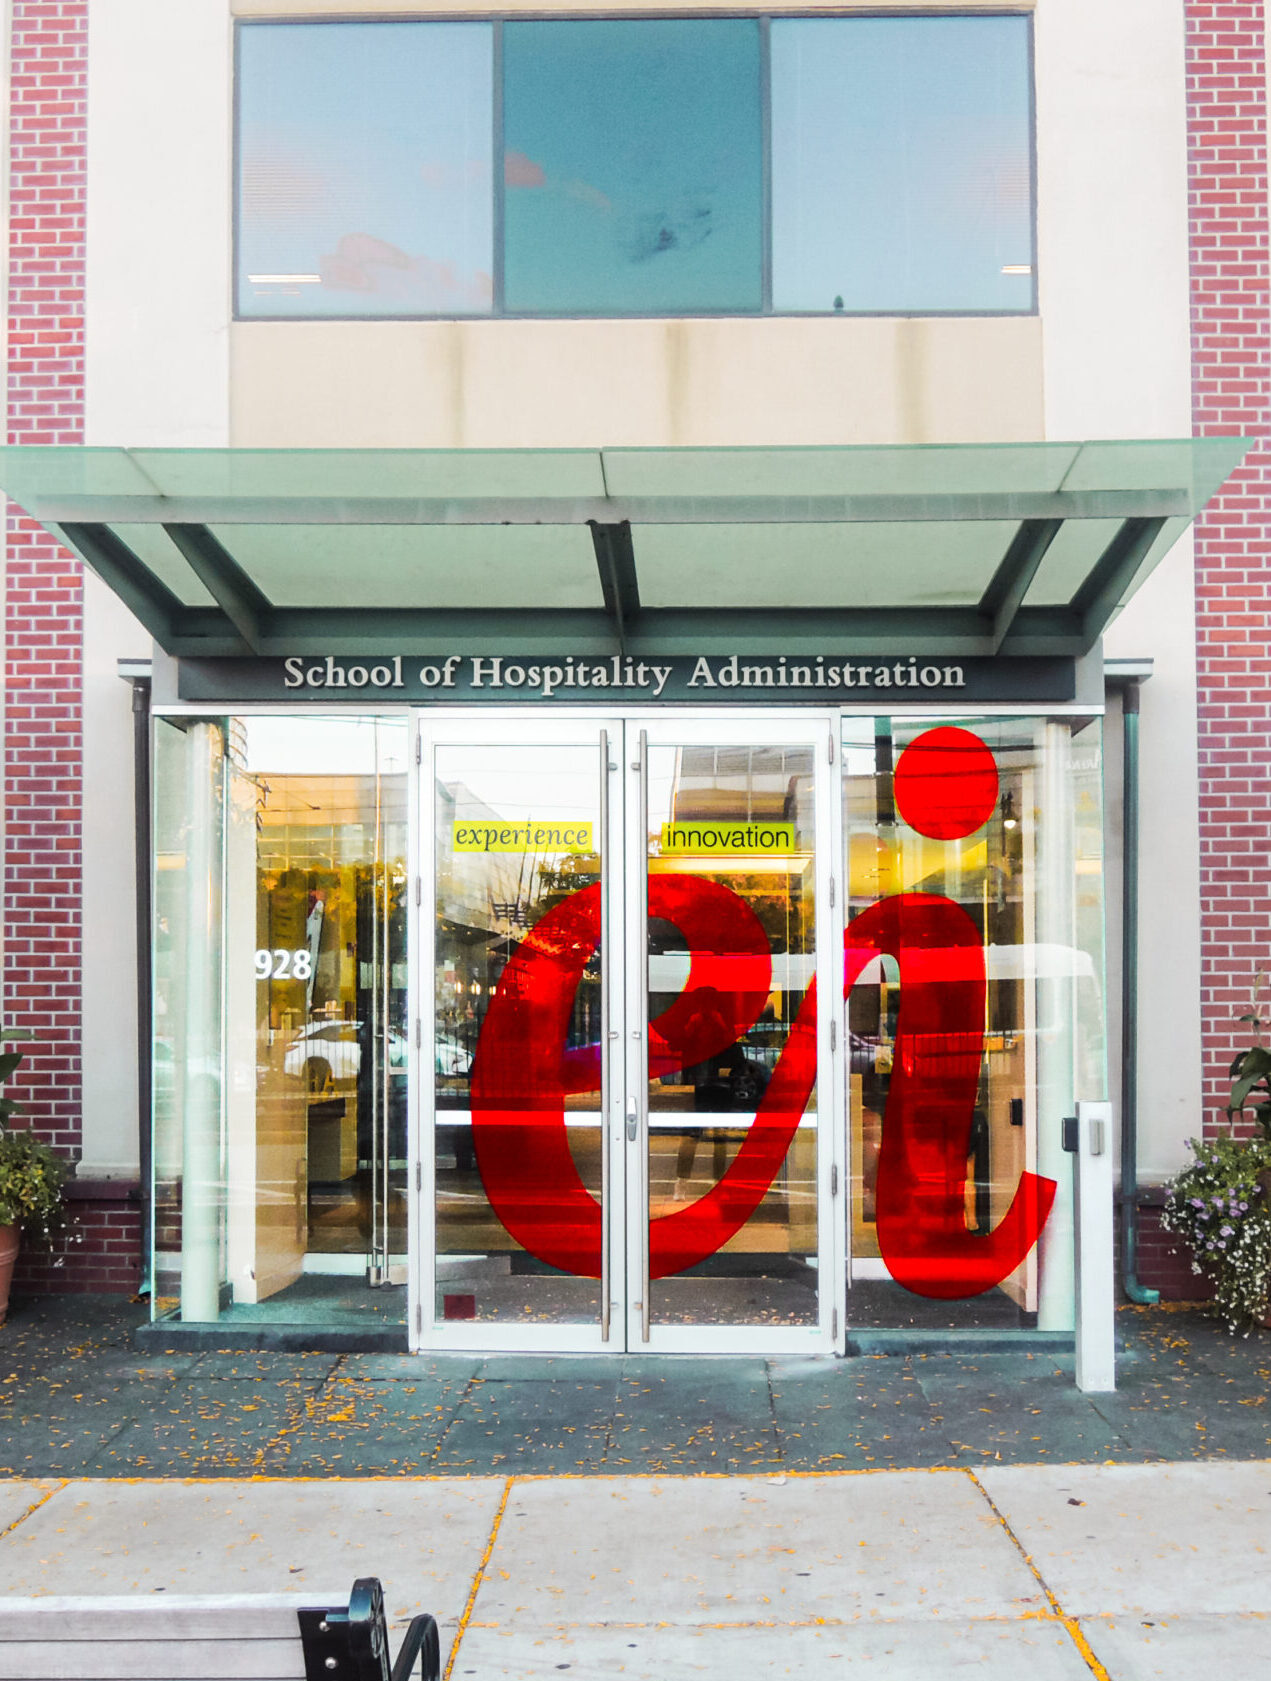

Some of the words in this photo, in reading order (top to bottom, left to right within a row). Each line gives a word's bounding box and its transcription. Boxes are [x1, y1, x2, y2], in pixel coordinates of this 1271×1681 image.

[284, 656, 404, 687] School
[419, 655, 462, 687] of
[470, 656, 673, 696] Hospitality
[687, 655, 966, 687] Administration
[456, 823, 588, 851] experience
[667, 824, 789, 848] innovation
[254, 949, 312, 980] 928
